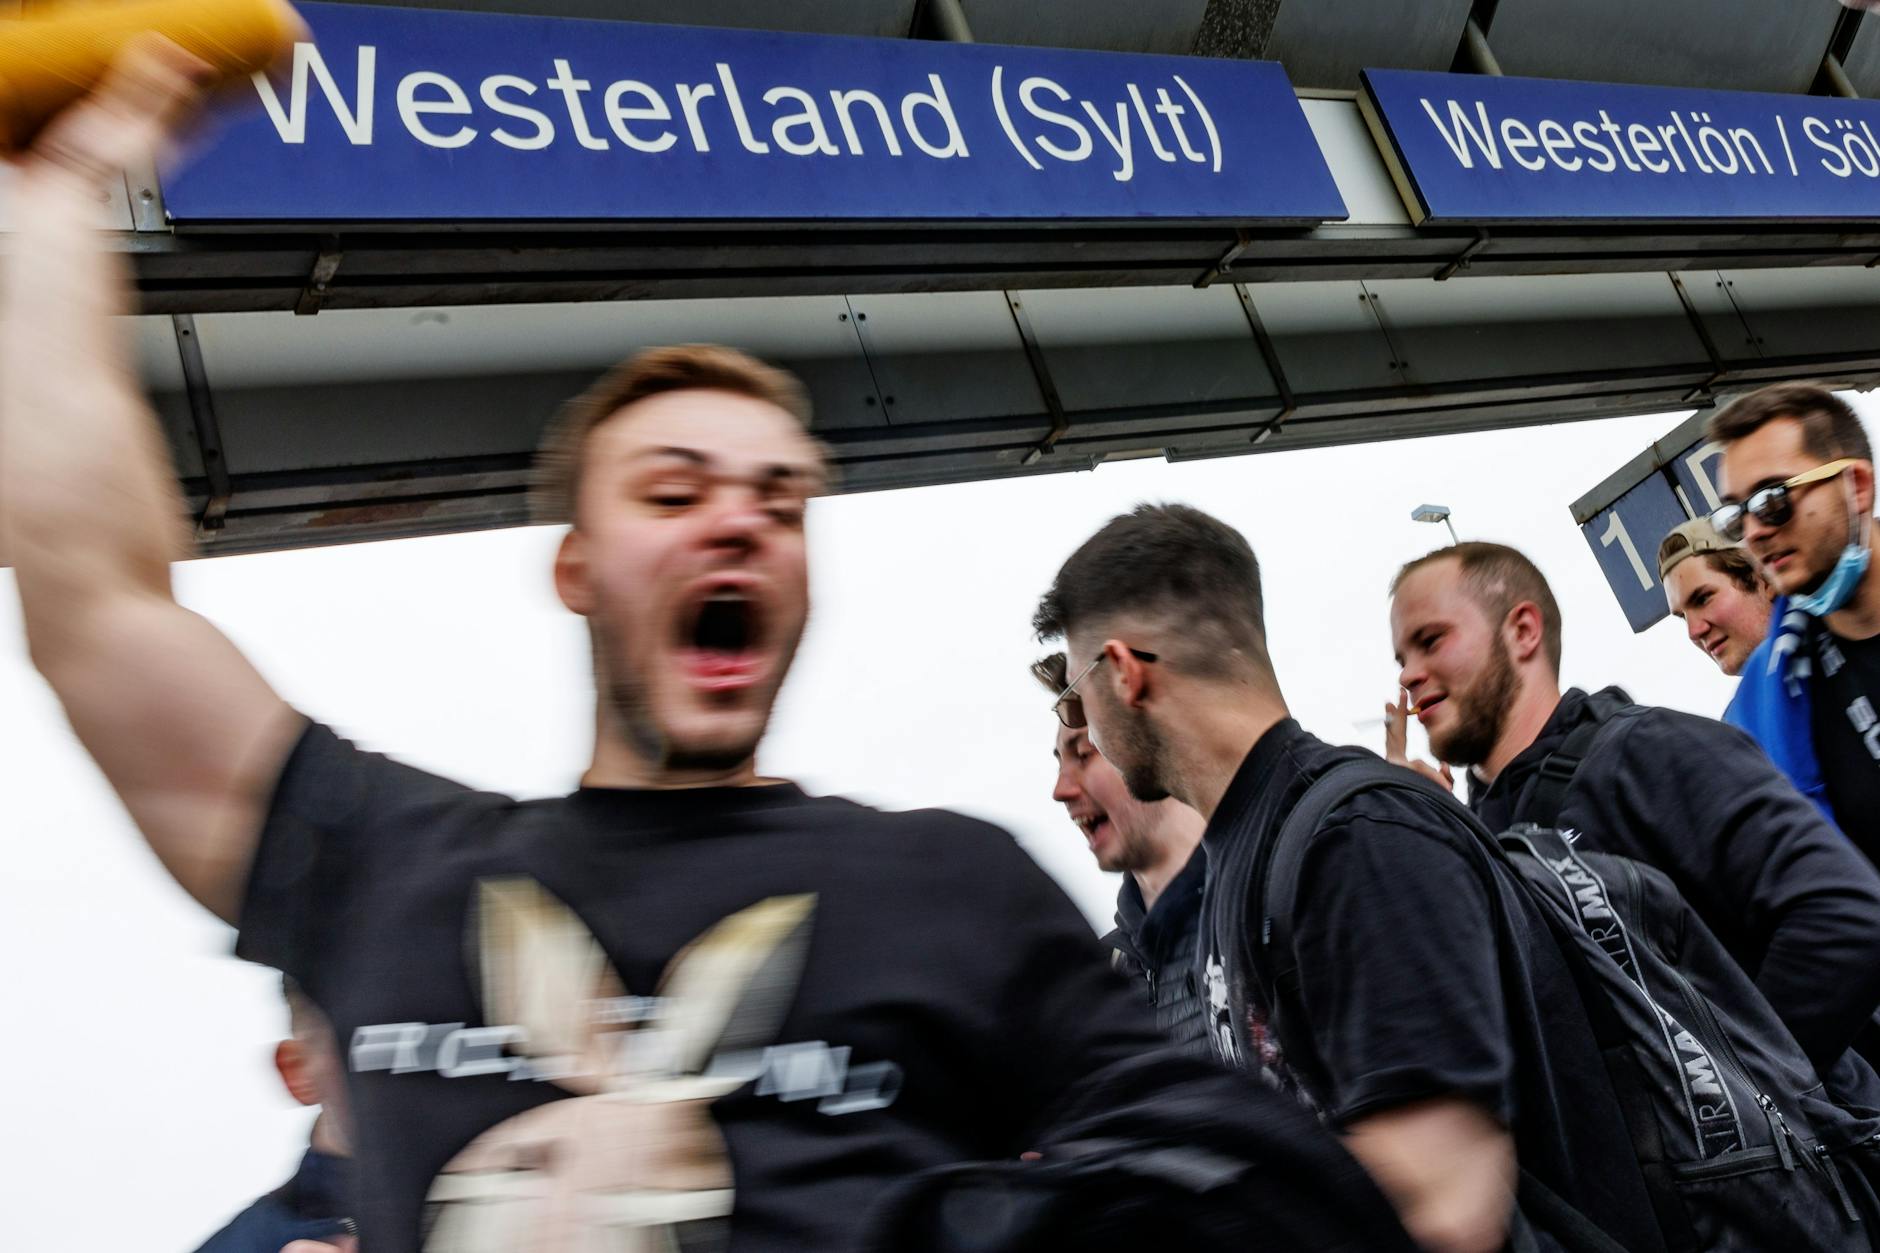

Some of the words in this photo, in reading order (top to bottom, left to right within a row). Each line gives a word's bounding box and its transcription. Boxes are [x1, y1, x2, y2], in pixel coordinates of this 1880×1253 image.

[252, 42, 970, 158] Westerland
[992, 66, 1222, 182] (Sylt)
[1420, 98, 1774, 175] Weesterlön
[1776, 115, 1799, 176] /
[1600, 510, 1655, 592] 1
[1546, 856, 1613, 919] MAX
[1590, 922, 1630, 969] IR
[1665, 1014, 1722, 1095] MA
